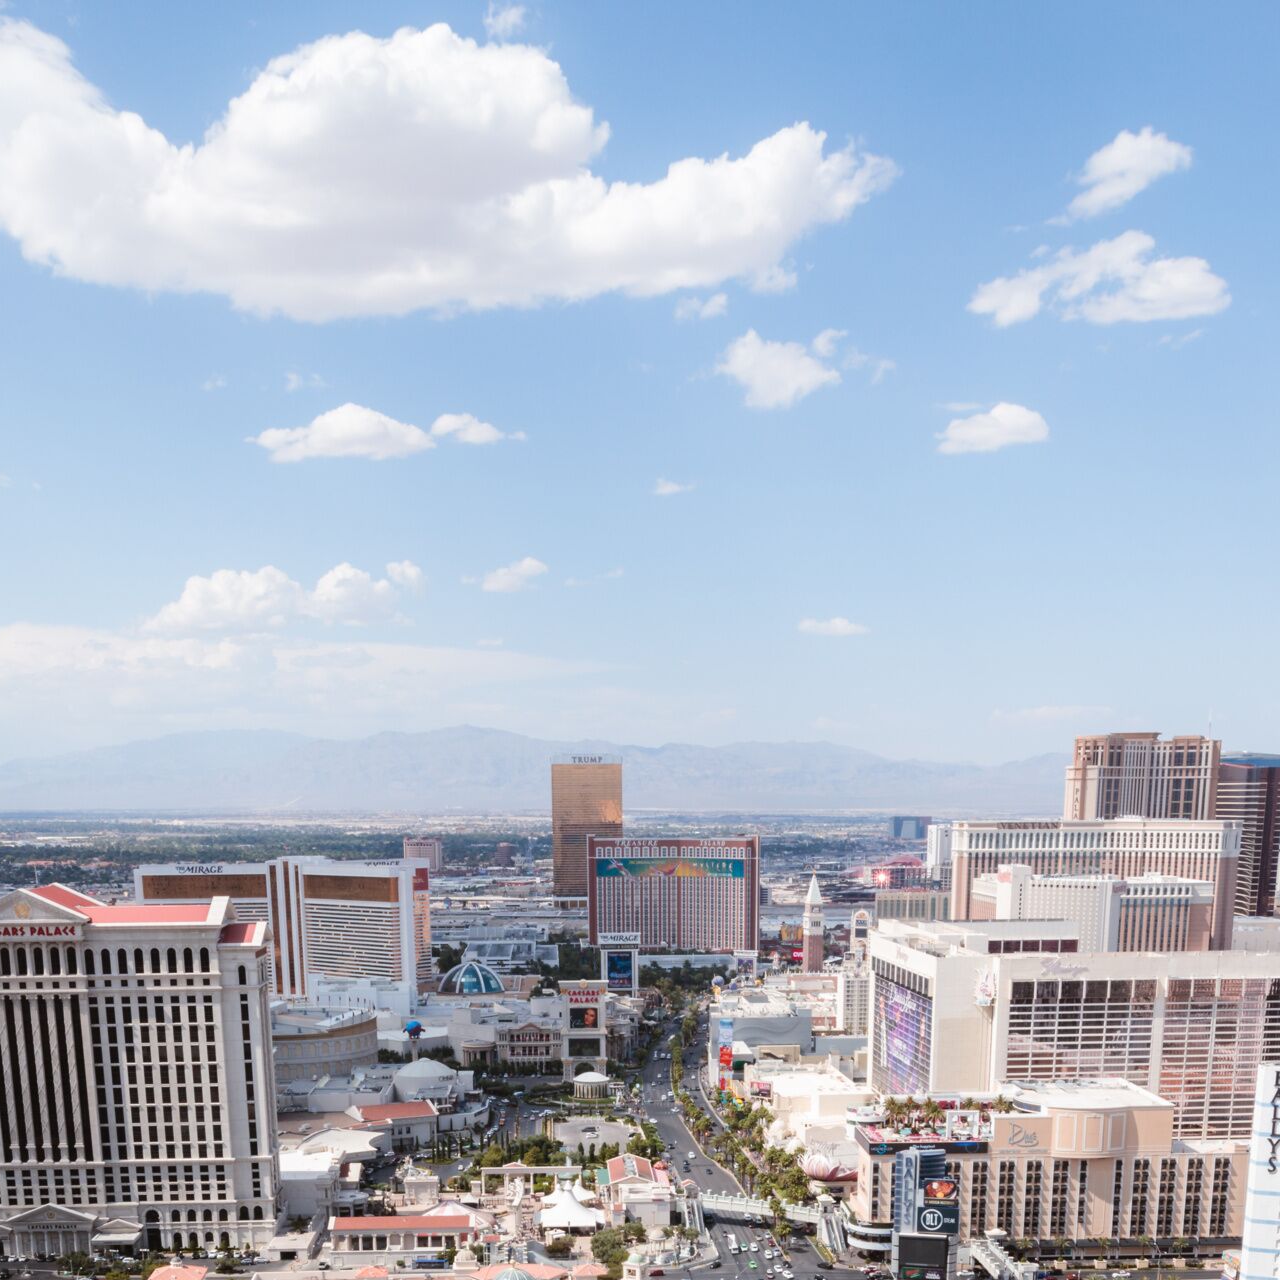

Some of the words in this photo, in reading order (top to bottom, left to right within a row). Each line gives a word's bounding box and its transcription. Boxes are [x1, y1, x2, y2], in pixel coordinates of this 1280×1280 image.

[185, 865, 223, 874] MIRAGE
[30, 926, 76, 936] PALACE
[925, 1213, 938, 1225] BLT
